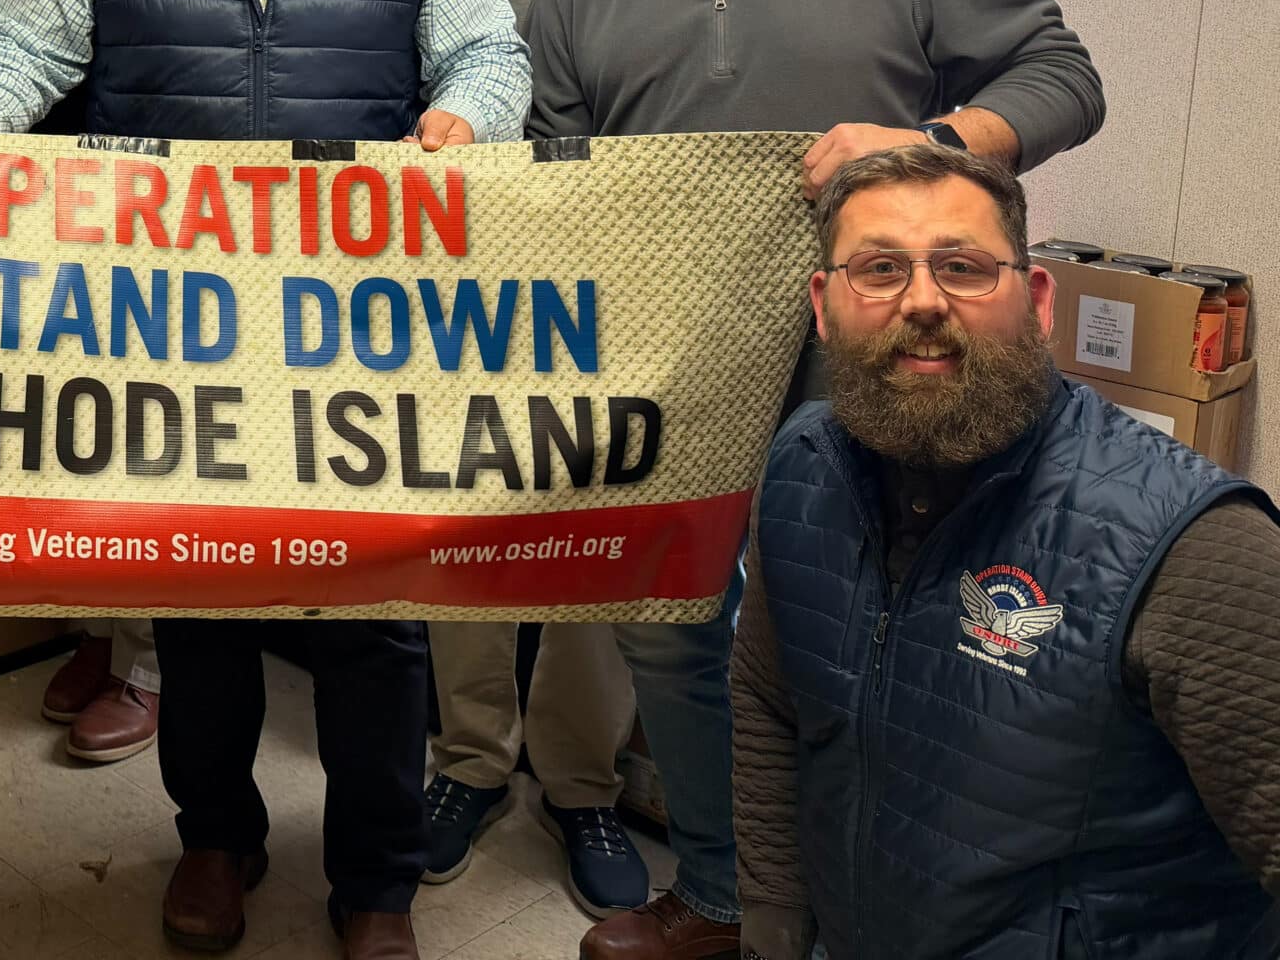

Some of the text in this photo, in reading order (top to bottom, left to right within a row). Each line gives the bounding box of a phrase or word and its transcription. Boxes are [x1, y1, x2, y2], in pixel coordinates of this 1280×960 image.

[282, 277, 600, 373] DOWN
[293, 388, 662, 491] ISLAND
[27, 528, 160, 563] Veterans
[170, 533, 256, 566] Since
[270, 538, 348, 567] 1993
[429, 533, 627, 566] www.osdri.org
[975, 565, 1048, 606] OPERATION STAND DOWN
[957, 642, 1027, 677] Serving Veterans Since 1993
